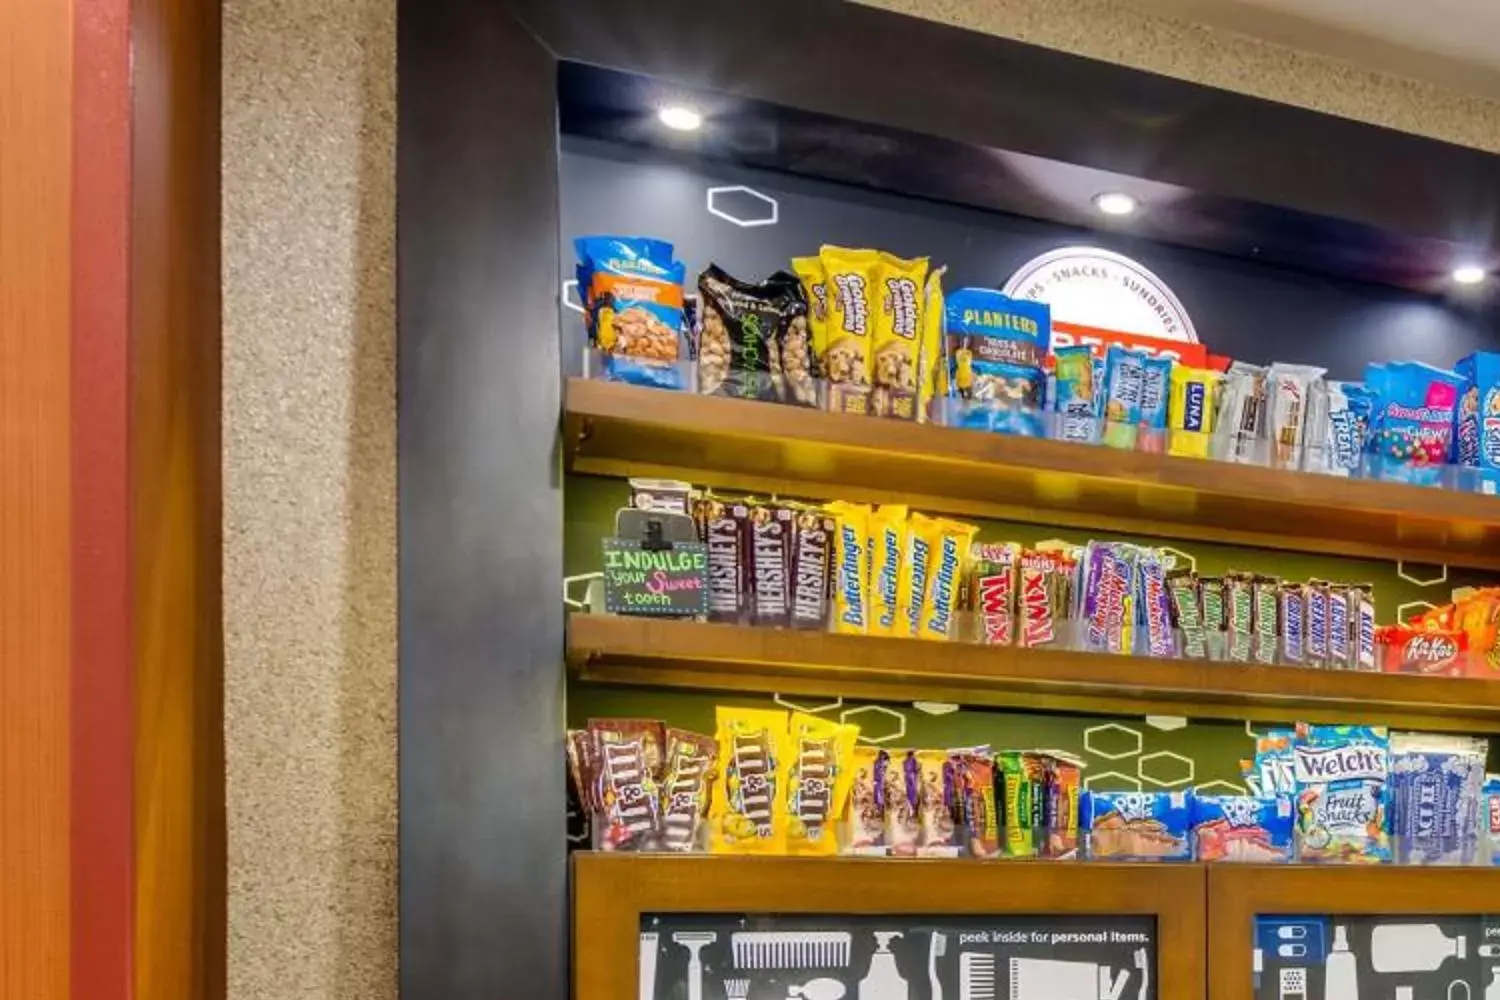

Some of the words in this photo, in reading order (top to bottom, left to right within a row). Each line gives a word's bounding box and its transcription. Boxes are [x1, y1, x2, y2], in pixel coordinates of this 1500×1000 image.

[1052, 265, 1109, 283] SNACKS
[1122, 275, 1178, 334] SUNDRIES
[962, 307, 1039, 337] PLANTERS
[1187, 384, 1203, 429] LUNA
[605, 550, 705, 571] INDULGE
[611, 570, 647, 587] your
[979, 566, 1012, 645] TWIX
[1311, 592, 1325, 654] SNICKERS
[1299, 749, 1385, 777] Welch's
[1325, 792, 1365, 809] Fruit
[1316, 807, 1371, 825] Snacks
[959, 931, 990, 945] peek
[993, 931, 1029, 944] inside
[1031, 931, 1049, 943] for
[1051, 931, 1108, 945] personal
